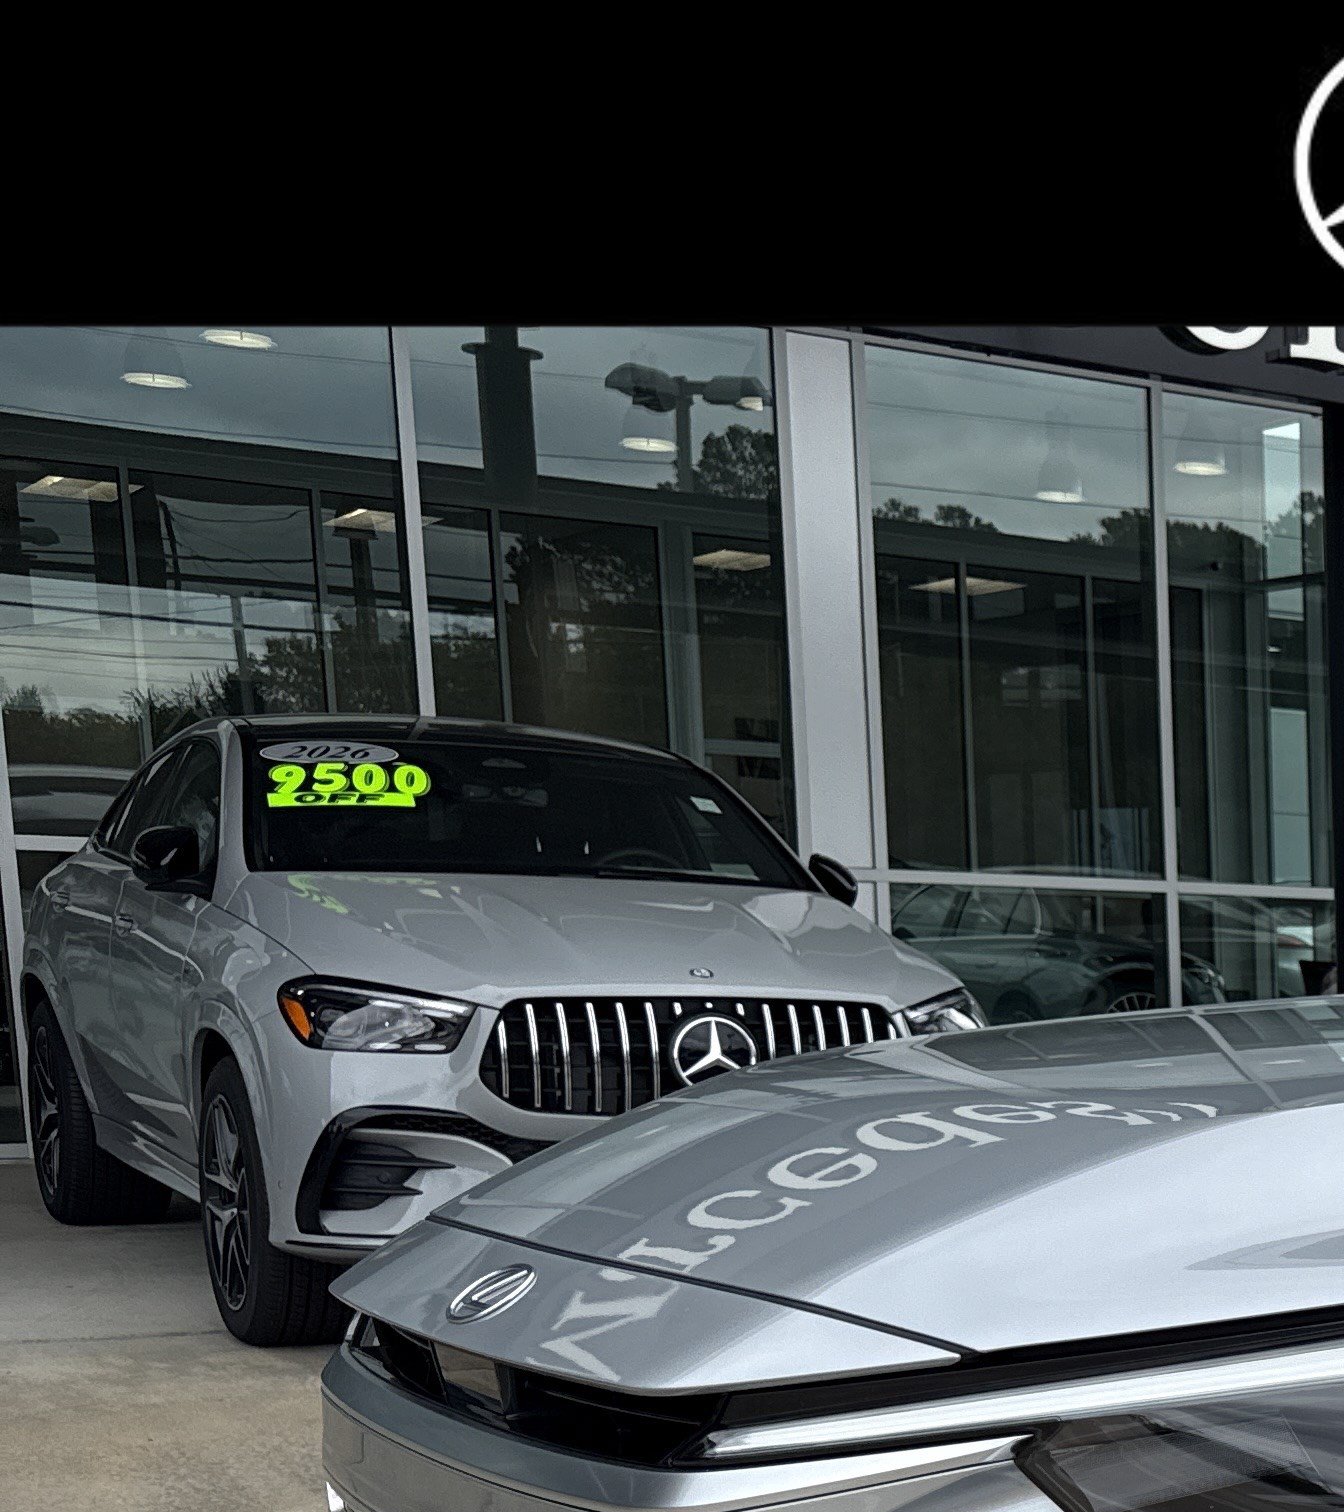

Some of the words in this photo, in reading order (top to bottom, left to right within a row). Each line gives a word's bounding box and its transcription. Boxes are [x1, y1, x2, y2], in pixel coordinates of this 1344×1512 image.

[284, 745, 370, 760] 2026
[268, 761, 432, 796] 9500
[294, 793, 385, 804] OFF
